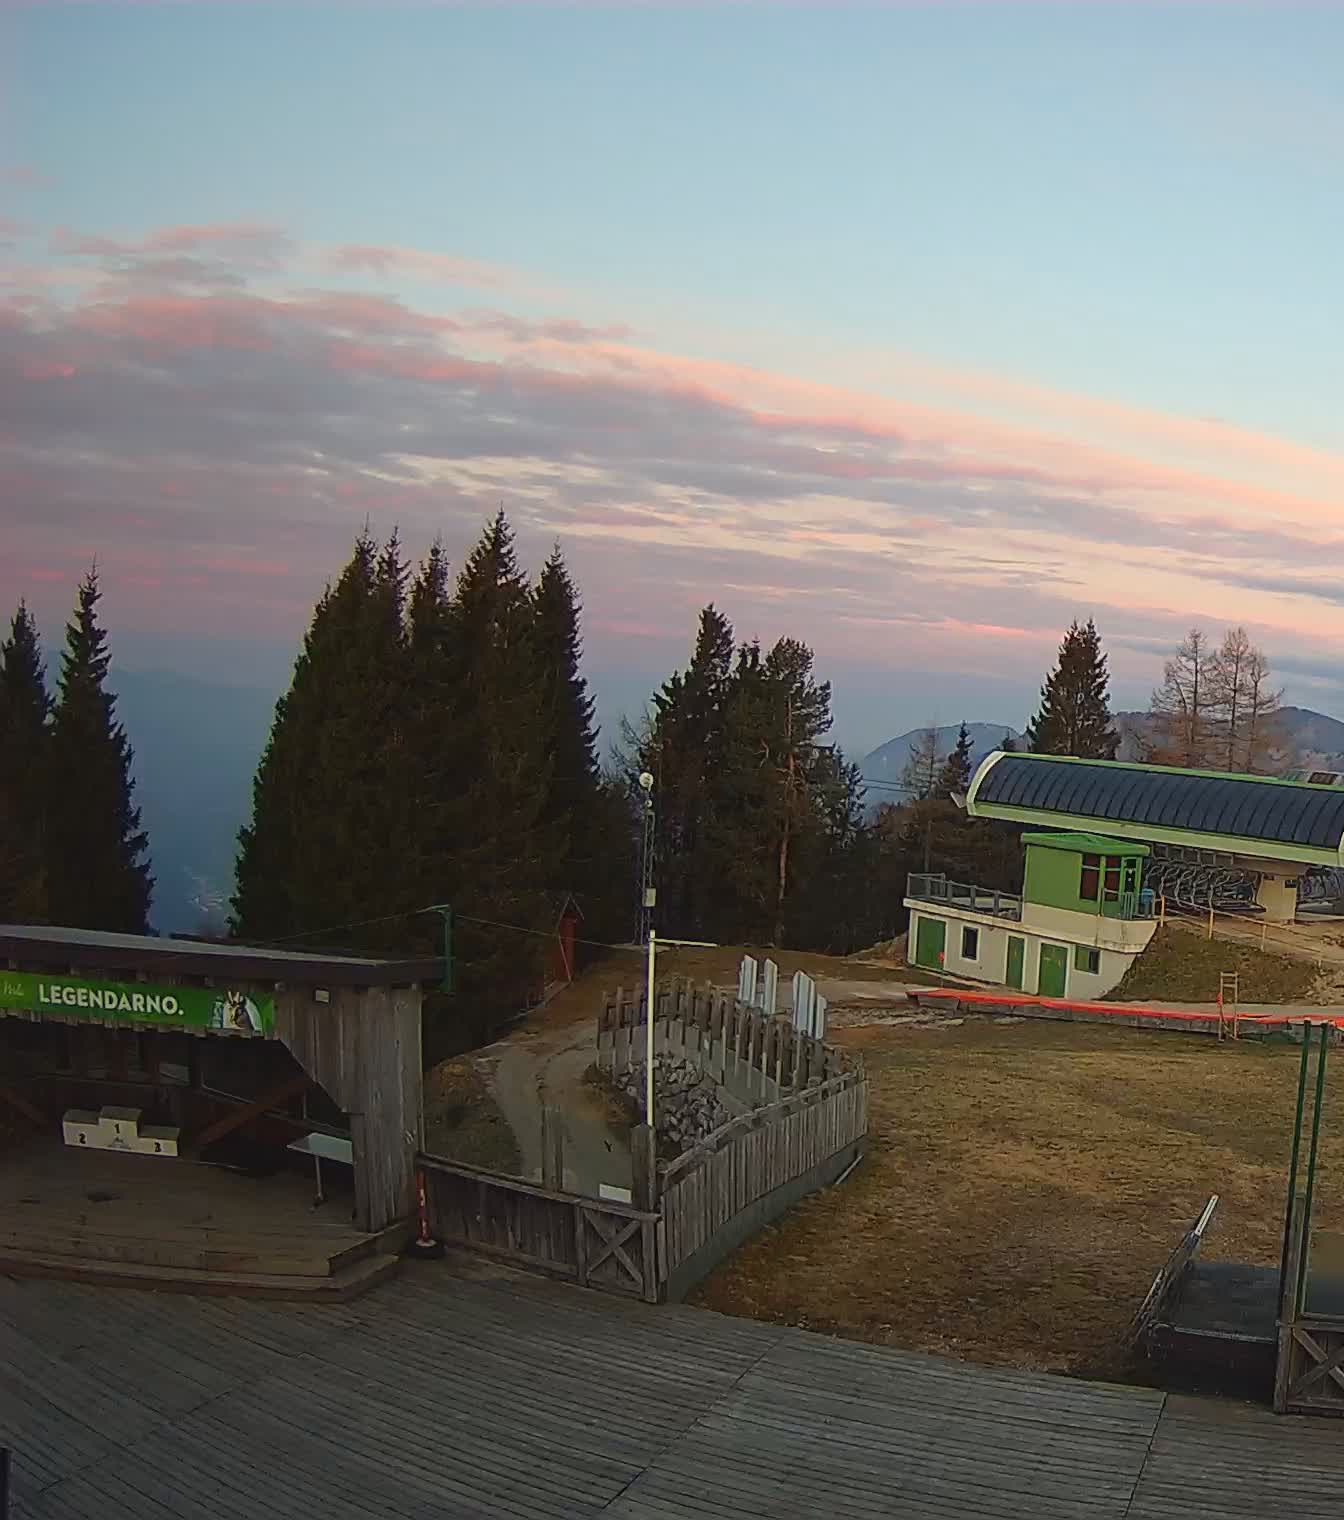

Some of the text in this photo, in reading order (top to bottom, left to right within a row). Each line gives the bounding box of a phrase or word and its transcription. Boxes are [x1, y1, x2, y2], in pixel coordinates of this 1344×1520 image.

[38, 983, 184, 1016] LEGENDARNO.
[114, 1123, 121, 1134] 1
[78, 1133, 87, 1145] 2
[154, 1141, 162, 1153] 3
